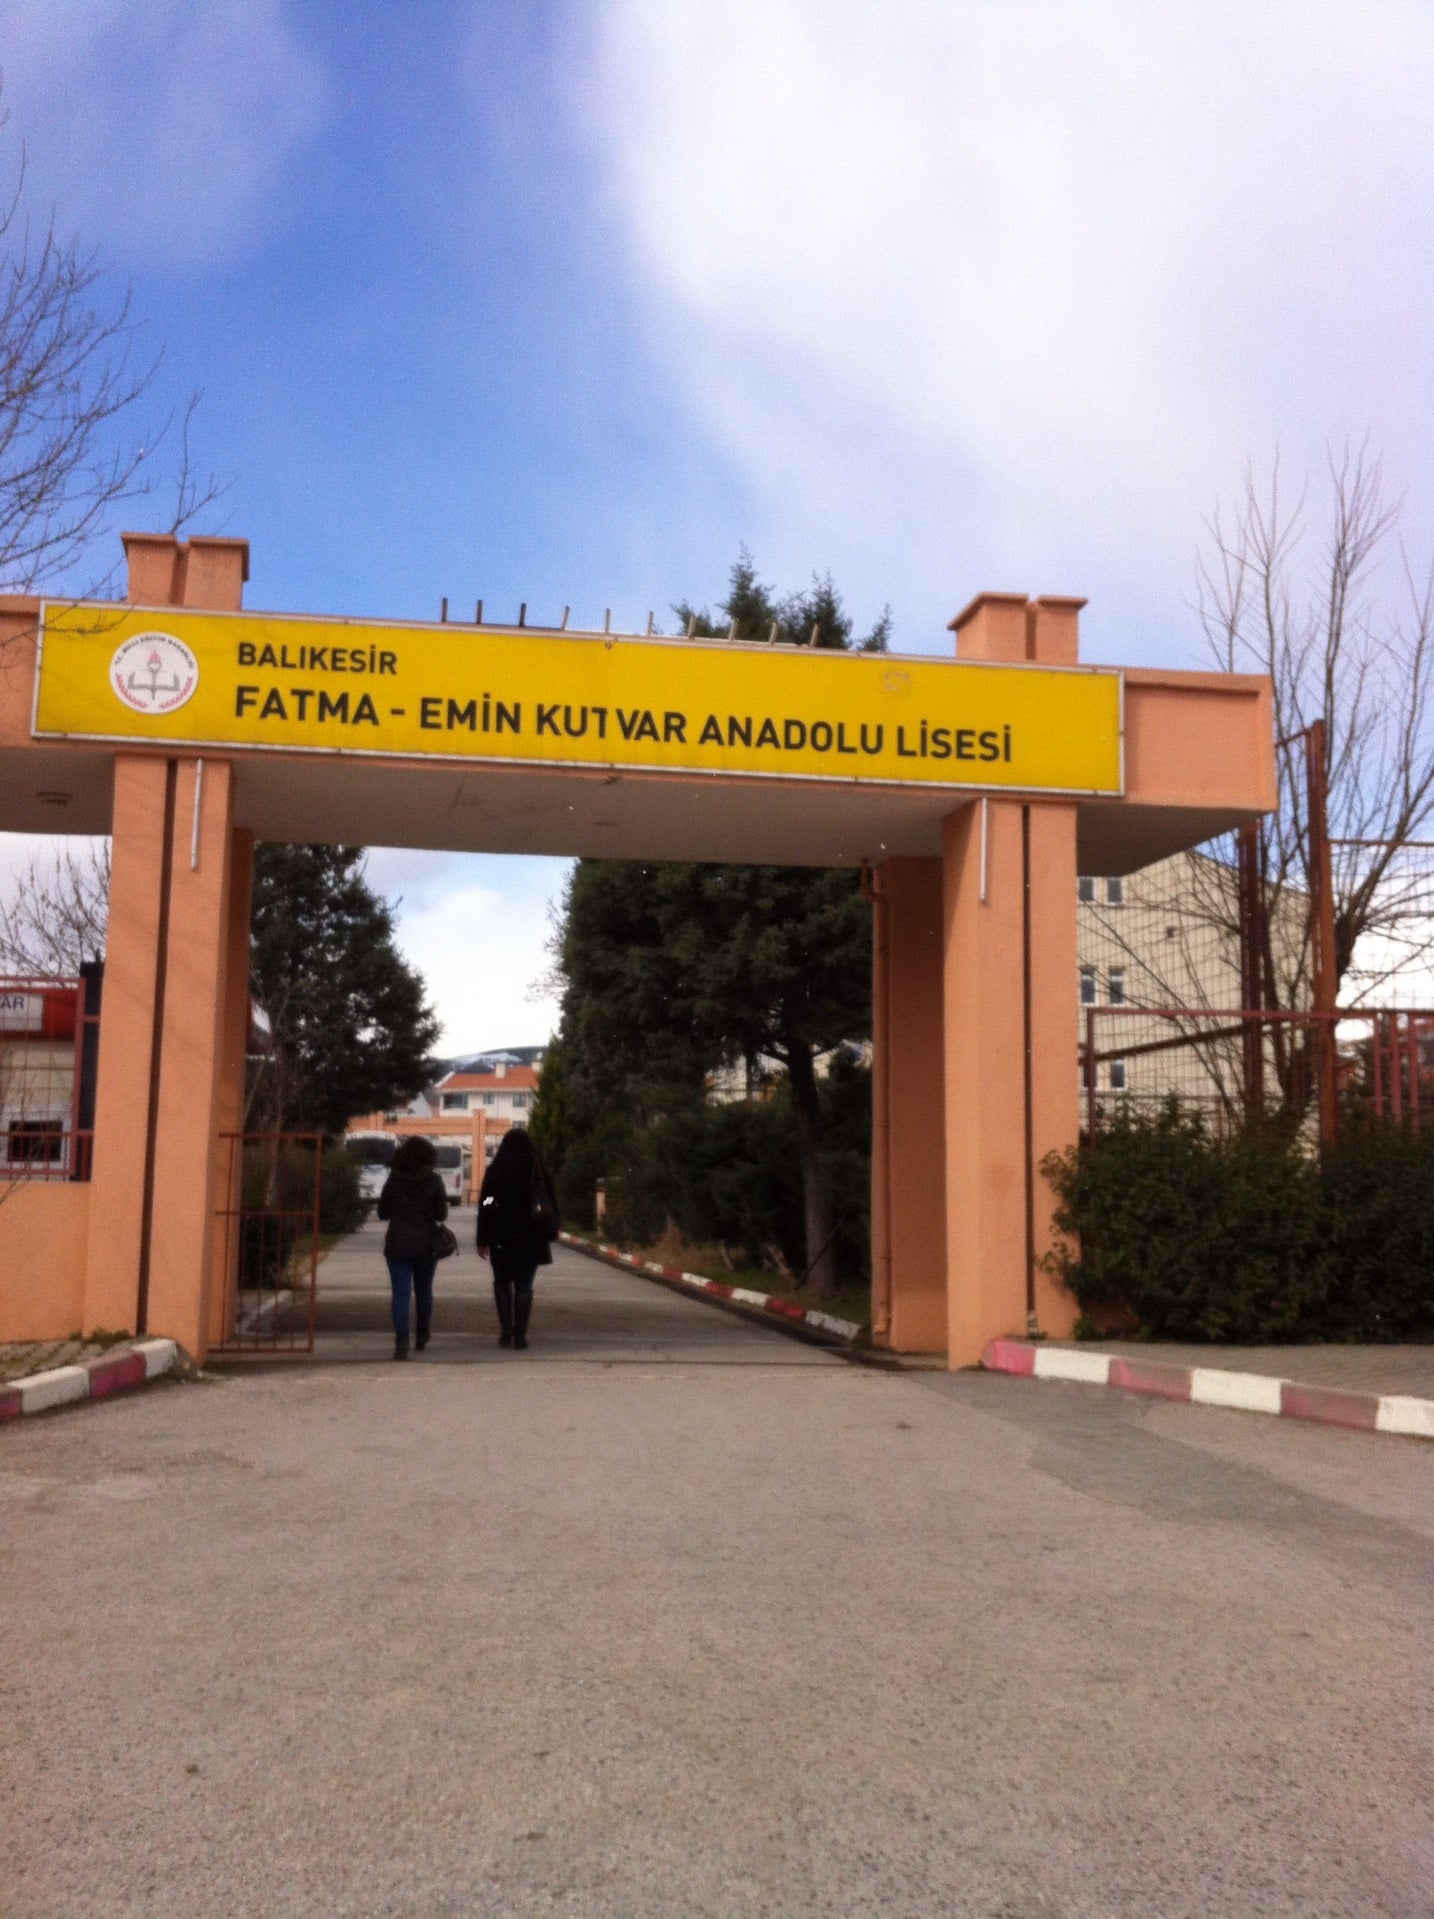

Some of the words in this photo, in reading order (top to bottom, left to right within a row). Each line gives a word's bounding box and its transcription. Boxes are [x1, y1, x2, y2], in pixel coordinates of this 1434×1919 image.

[238, 642, 398, 675] BALIKESİR
[235, 685, 380, 726] FATMA
[420, 692, 521, 734] EMİN
[699, 714, 884, 755] ANADOLU
[897, 719, 1012, 762] LİSESİ
